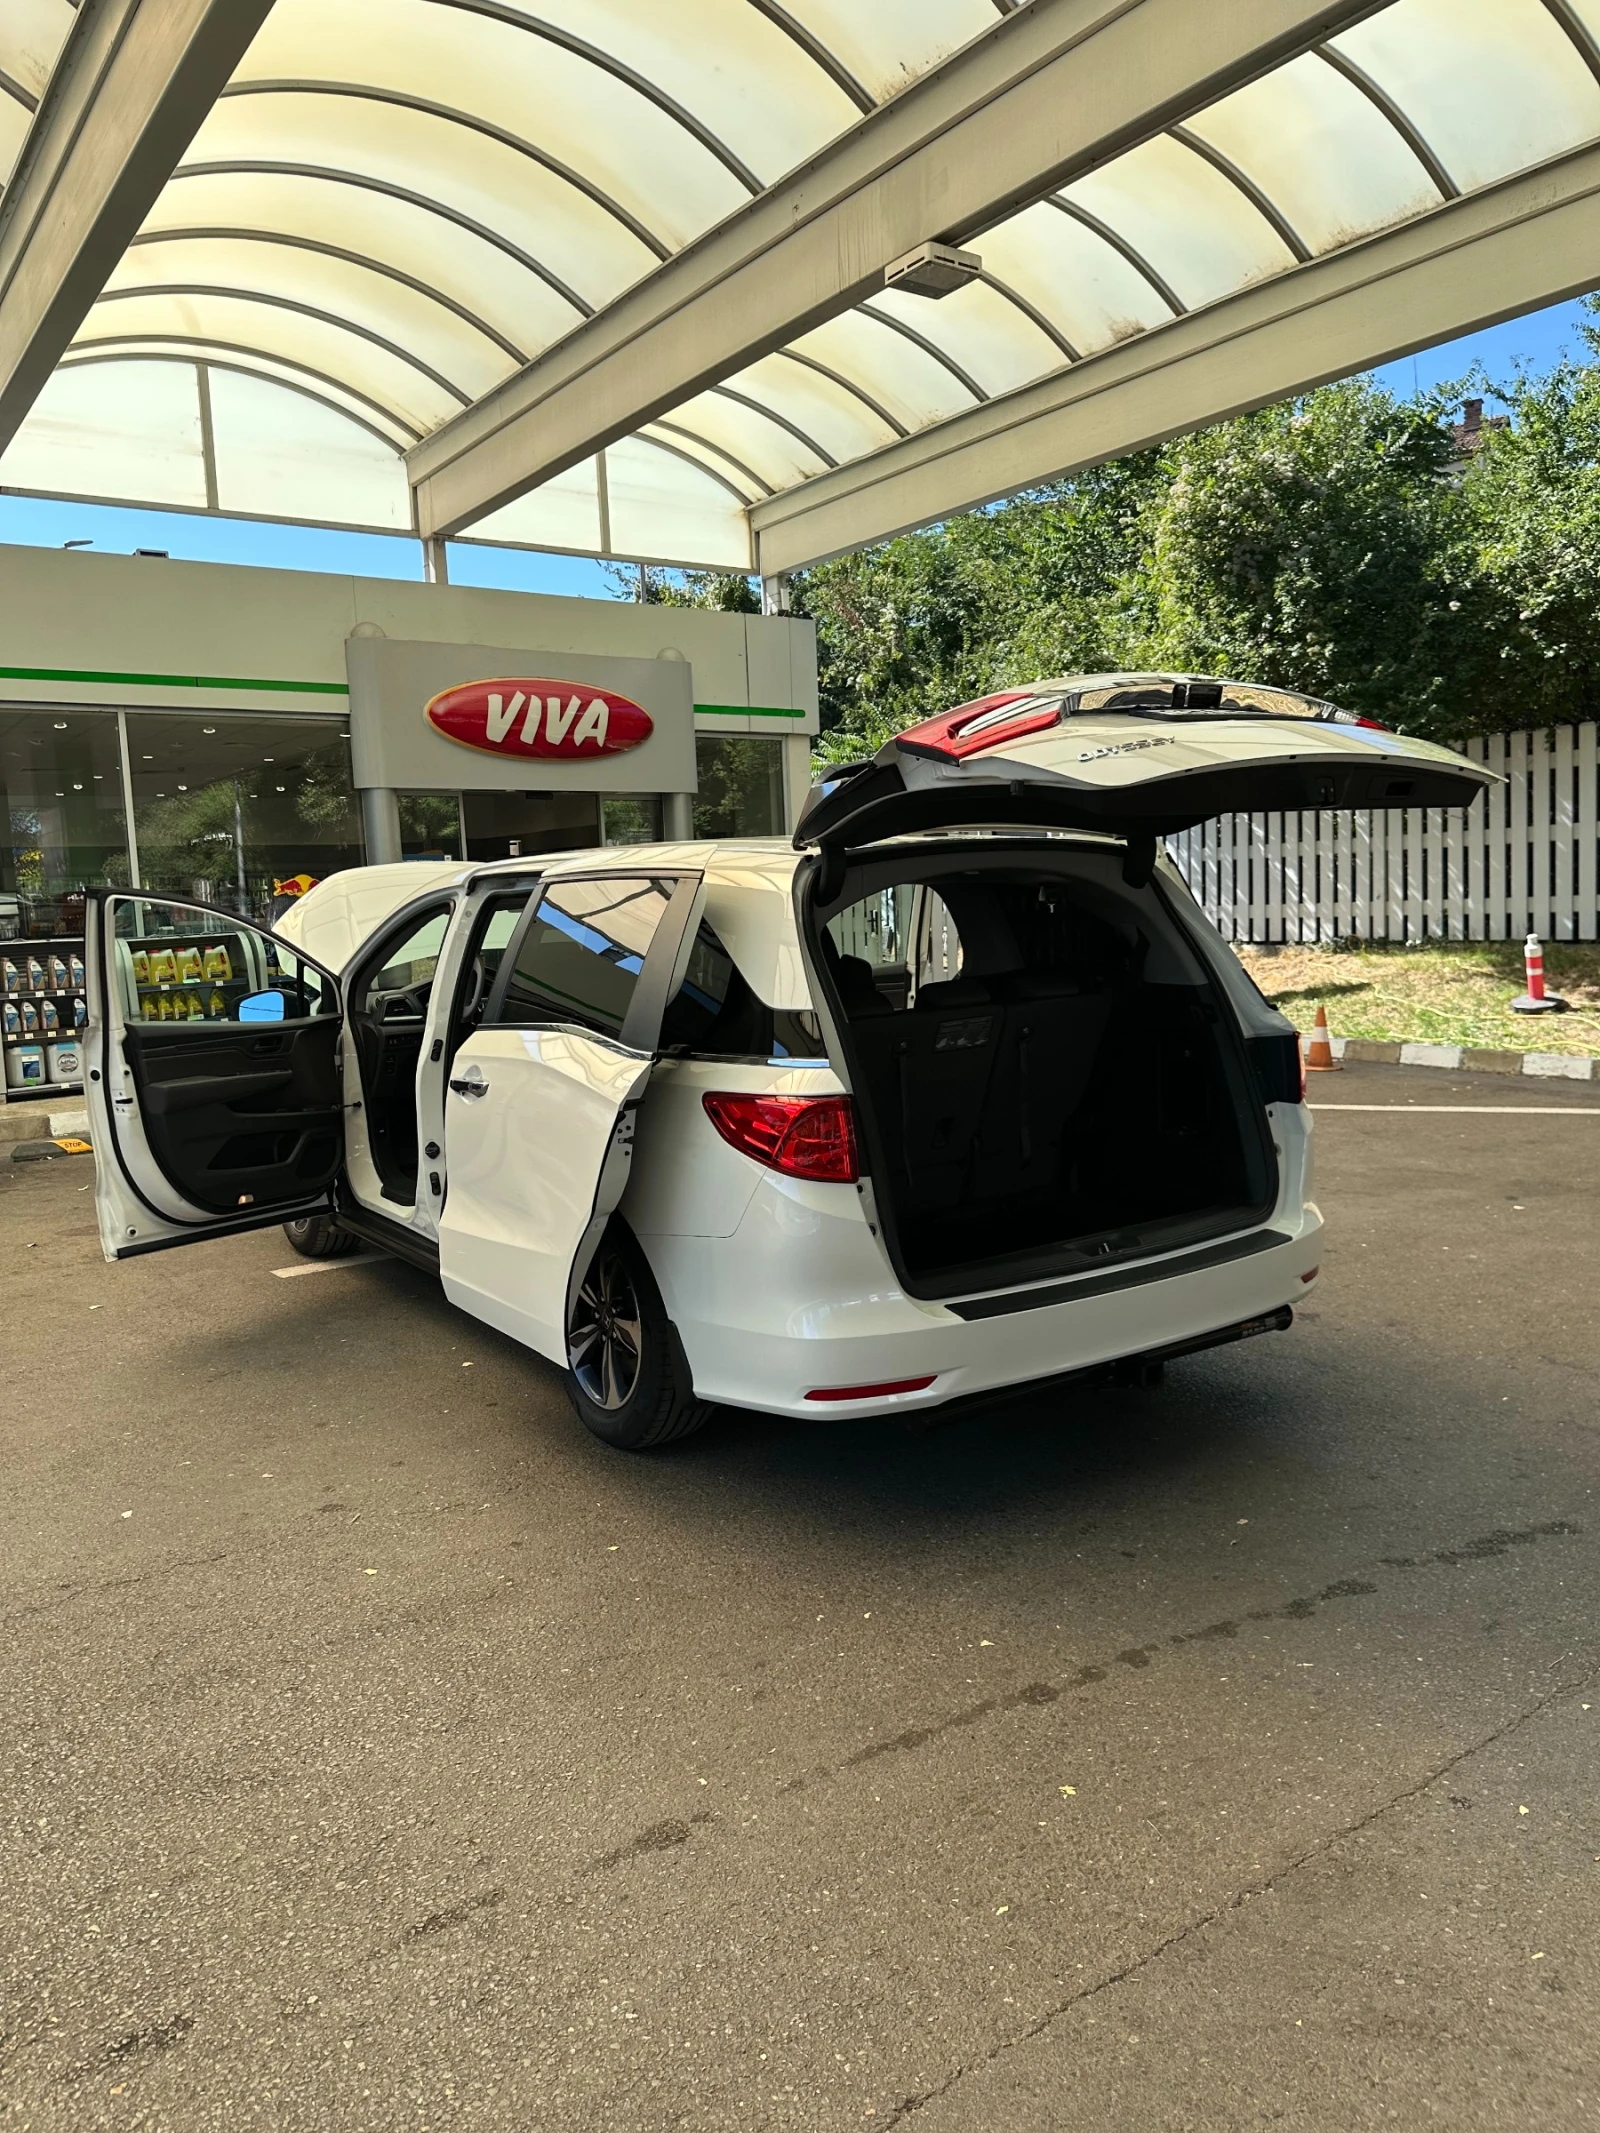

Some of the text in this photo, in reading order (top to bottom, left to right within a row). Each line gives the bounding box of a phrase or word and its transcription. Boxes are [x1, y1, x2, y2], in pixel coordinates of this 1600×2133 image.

[486, 690, 609, 747] VIVA
[1076, 736, 1175, 763] ODYSSEY
[64, 1141, 82, 1149] STOP
